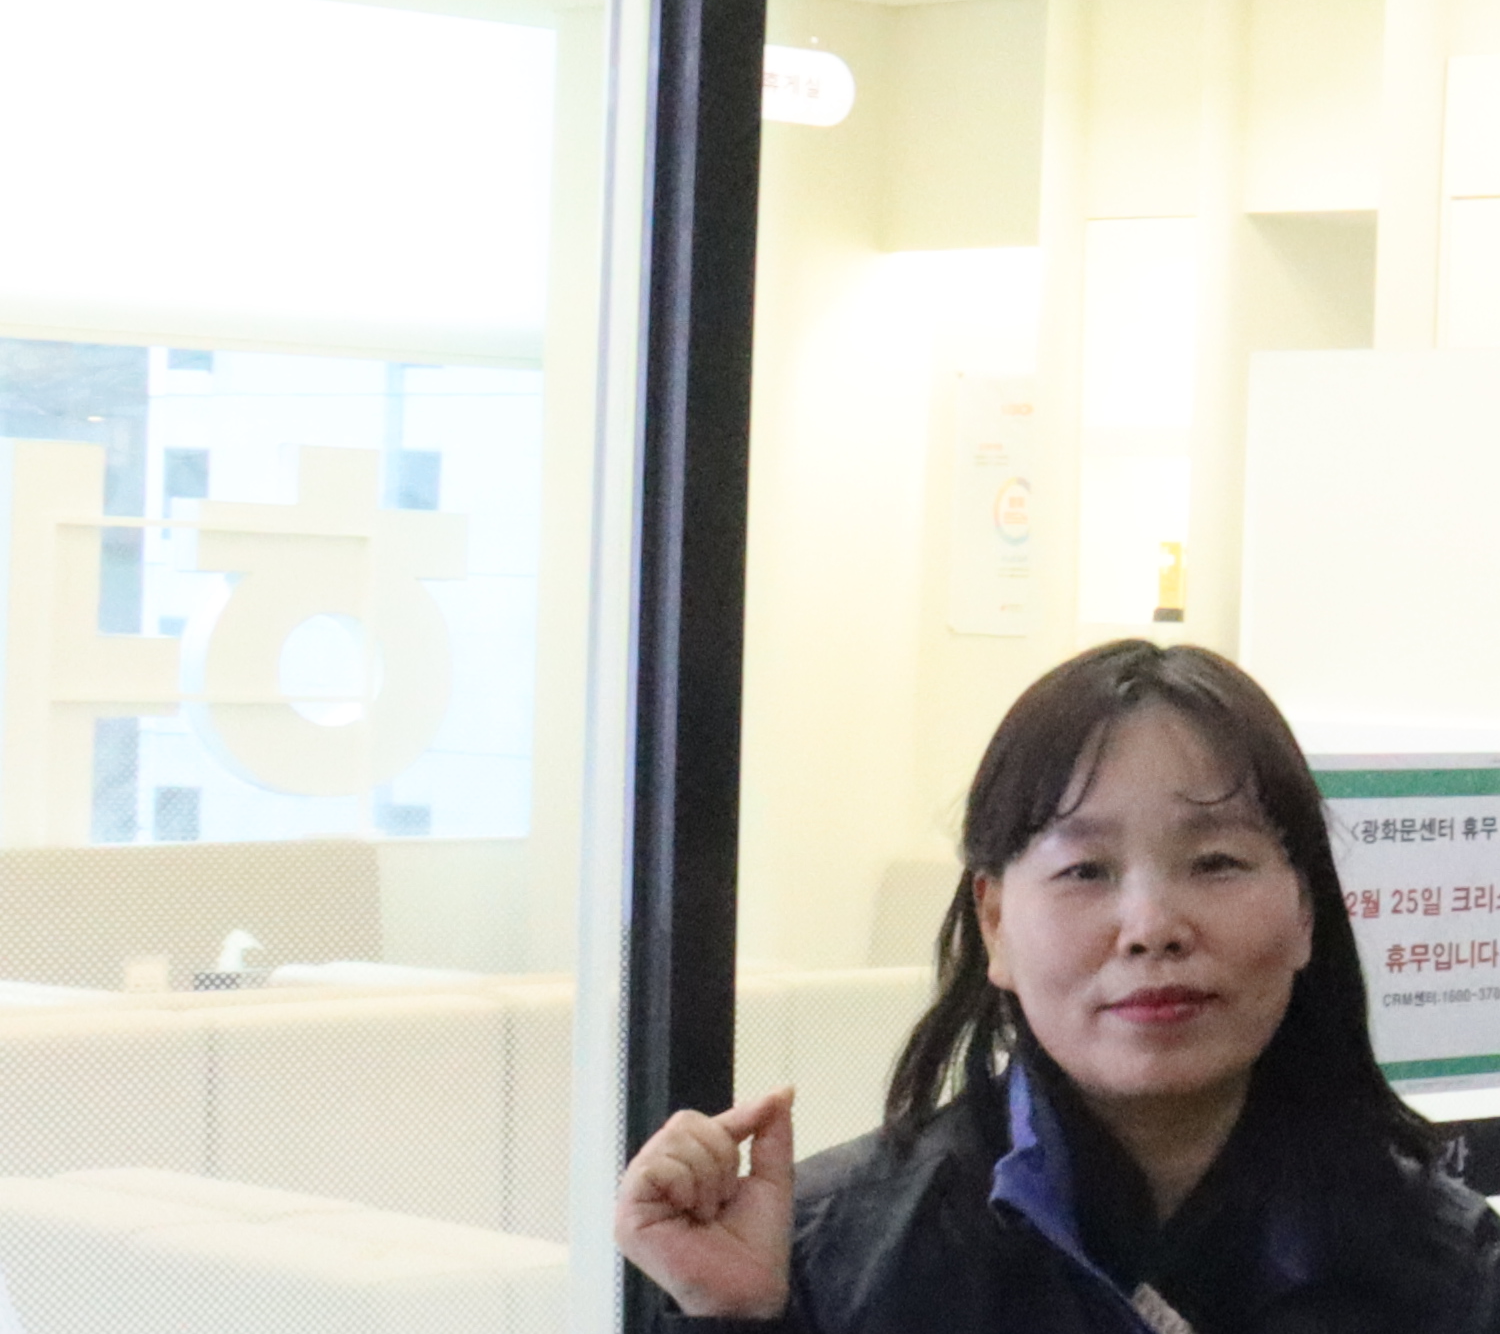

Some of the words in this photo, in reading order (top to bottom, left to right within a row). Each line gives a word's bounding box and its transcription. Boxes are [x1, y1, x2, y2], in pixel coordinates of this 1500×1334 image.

[1461, 816, 1498, 841] 휴무
[1345, 887, 1381, 918] 2월
[1390, 886, 1442, 917] 25일
